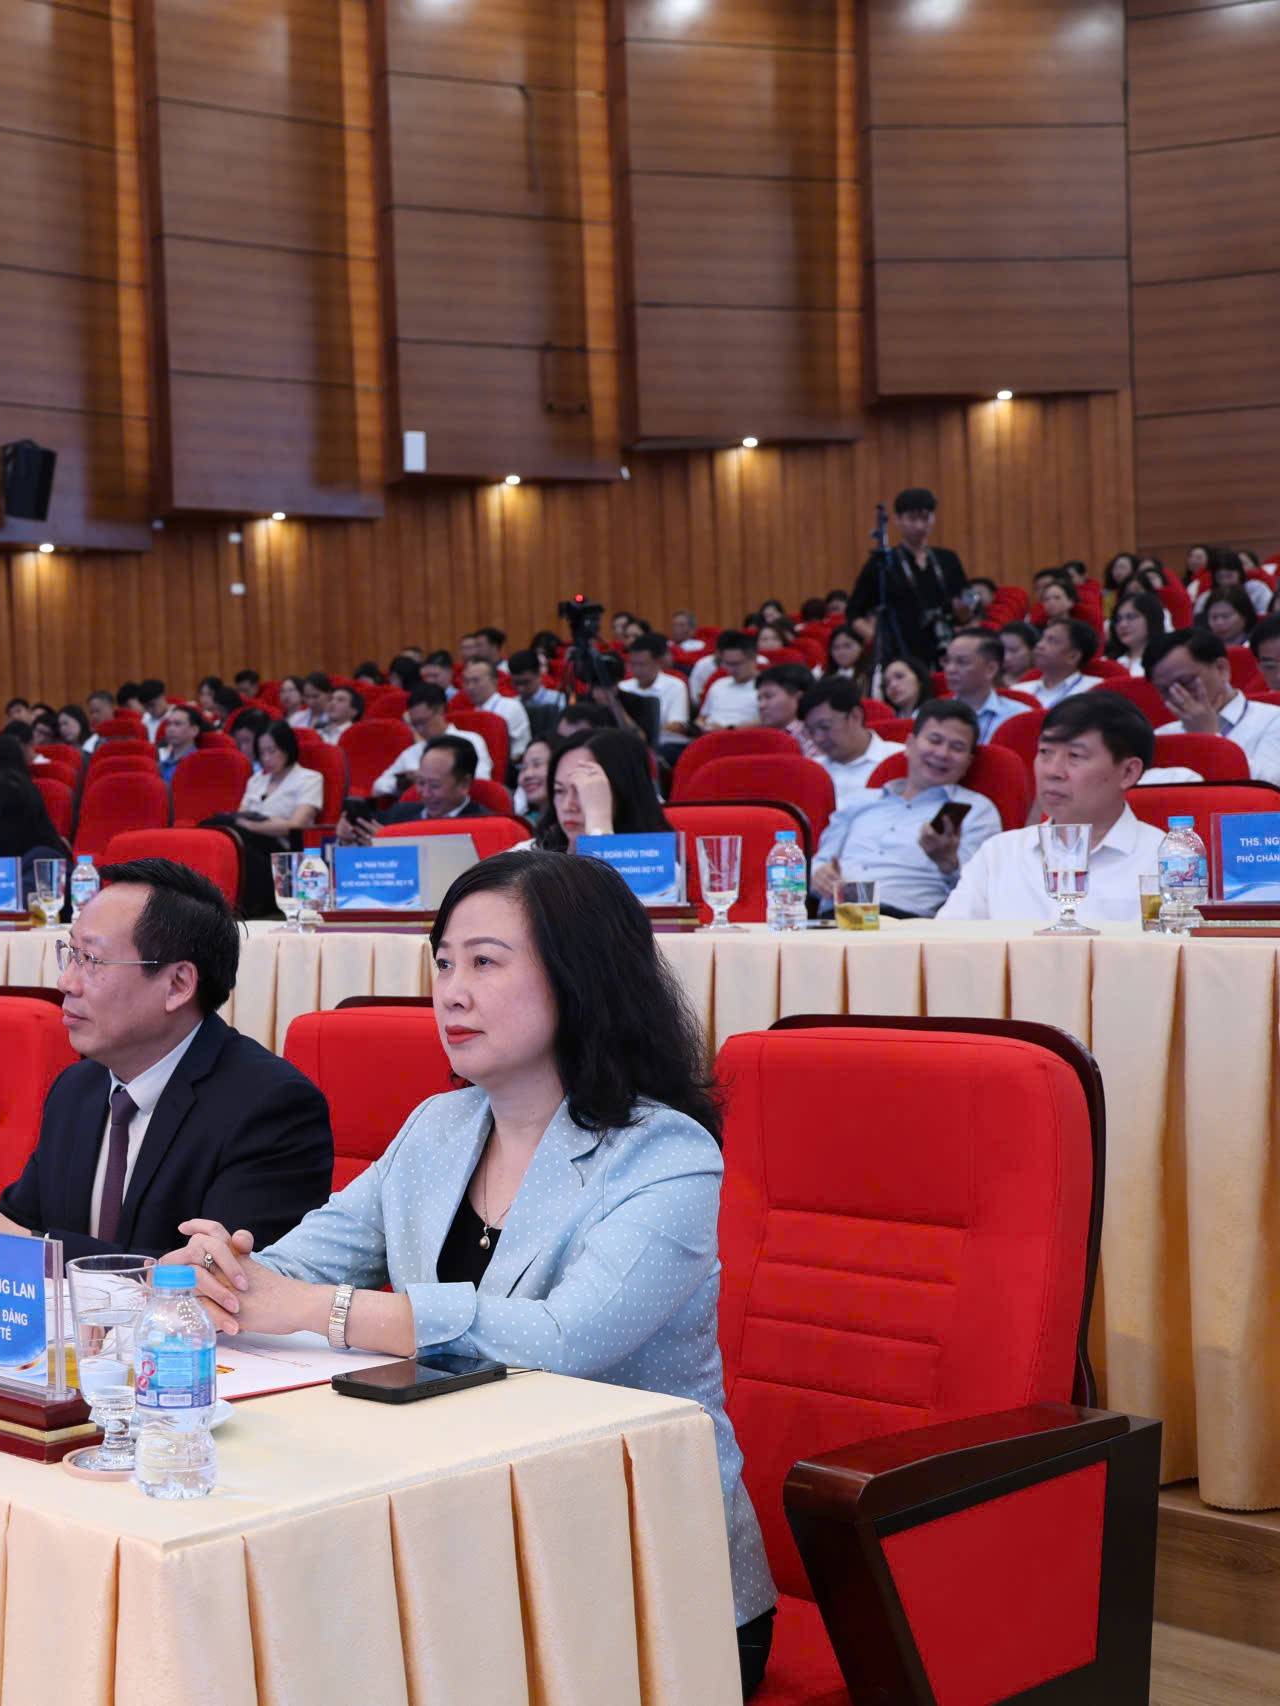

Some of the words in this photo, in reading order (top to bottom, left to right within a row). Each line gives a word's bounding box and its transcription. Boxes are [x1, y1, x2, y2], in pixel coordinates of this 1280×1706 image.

[12, 1280, 36, 1300] LAN
[2, 1308, 28, 1326] ĐẢNG
[0, 1324, 12, 1341] TẾ
